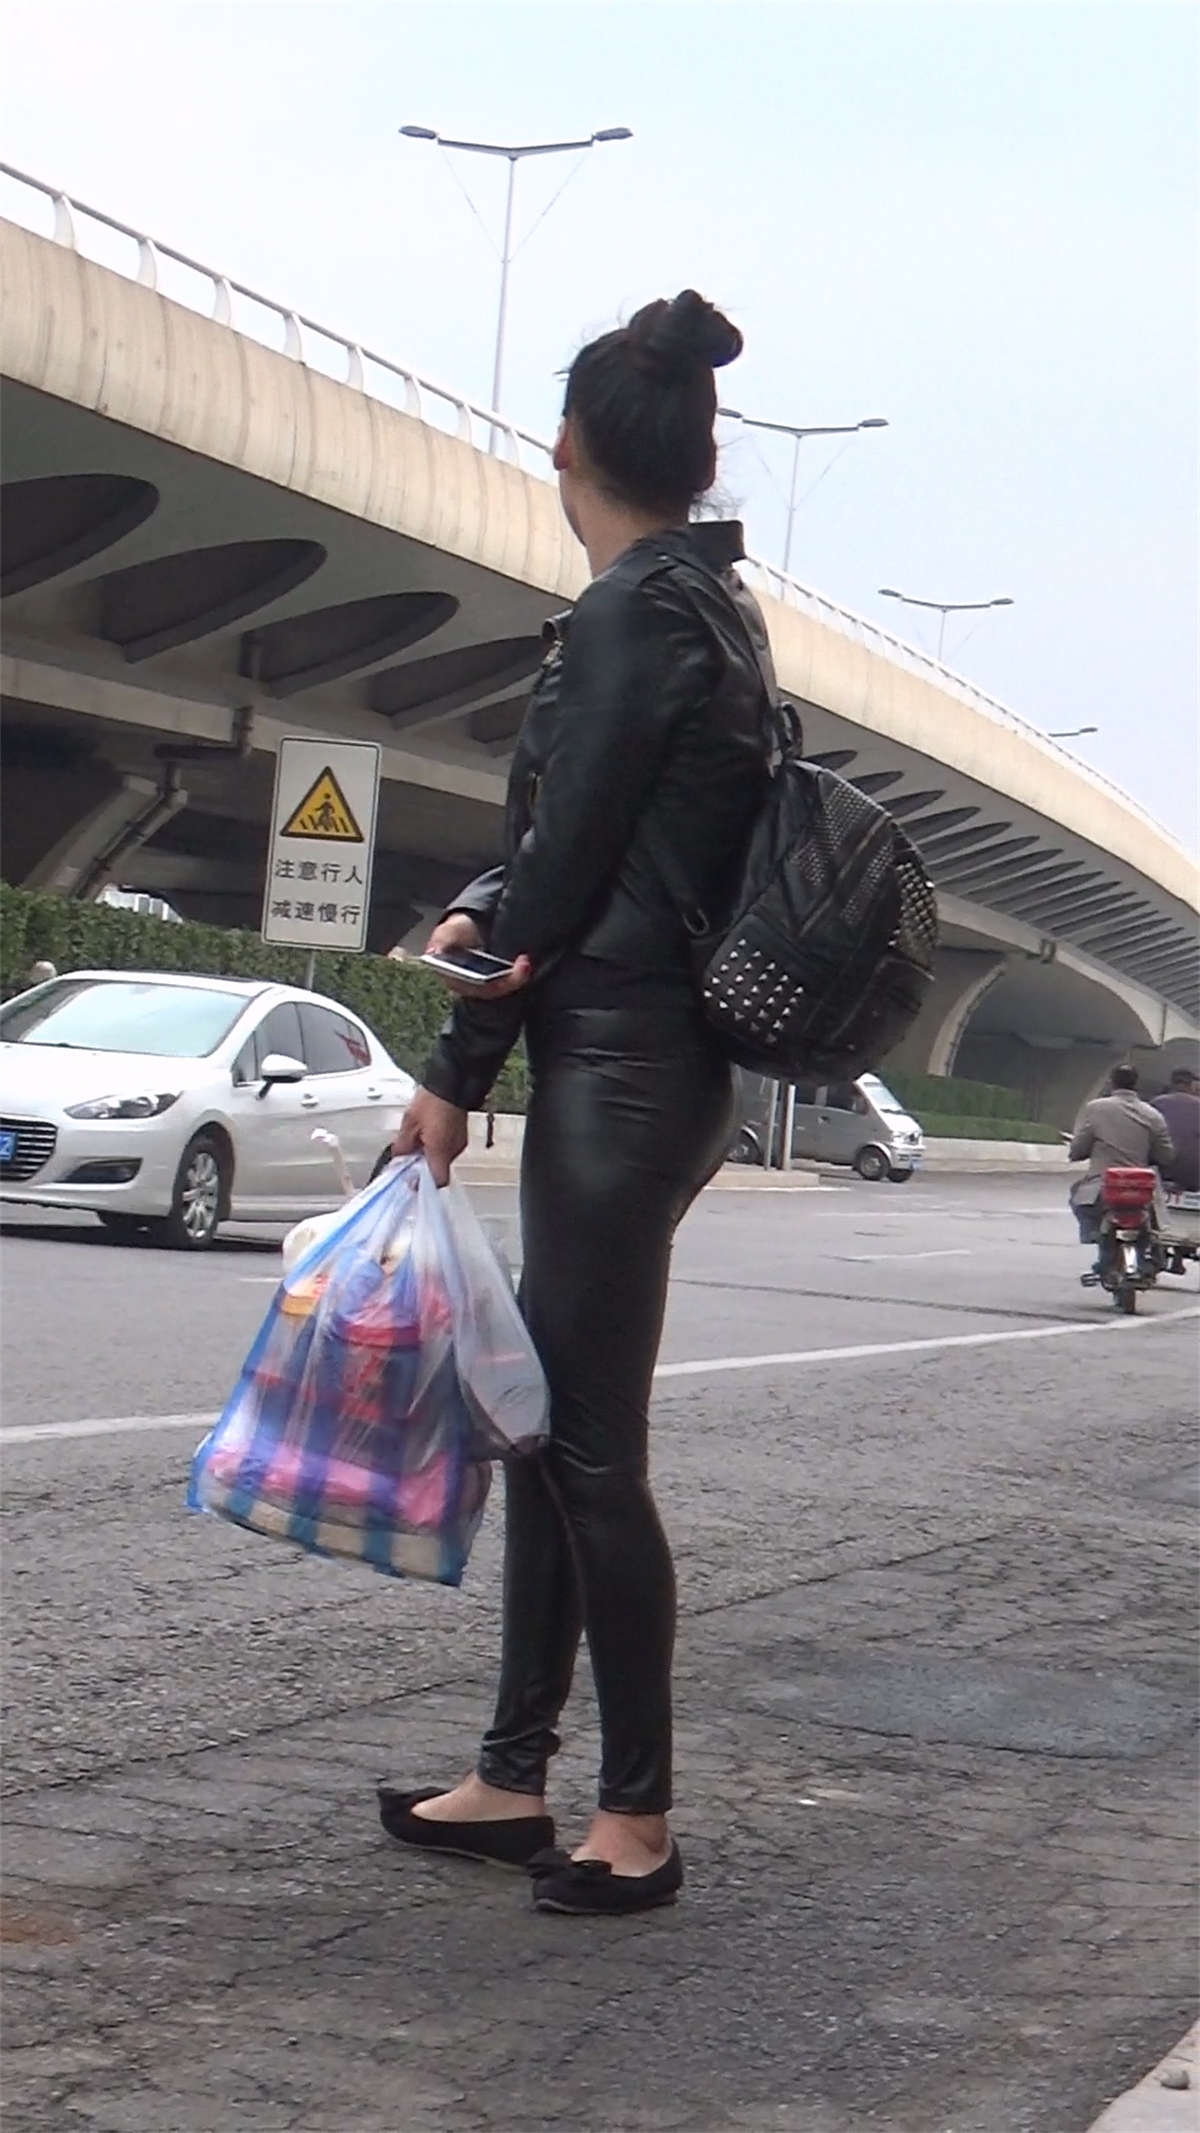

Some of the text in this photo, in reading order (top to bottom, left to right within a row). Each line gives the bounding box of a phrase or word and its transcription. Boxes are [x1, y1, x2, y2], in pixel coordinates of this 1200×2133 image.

[275, 859, 363, 885] 注意行人
[271, 900, 361, 925] 减速慢行
